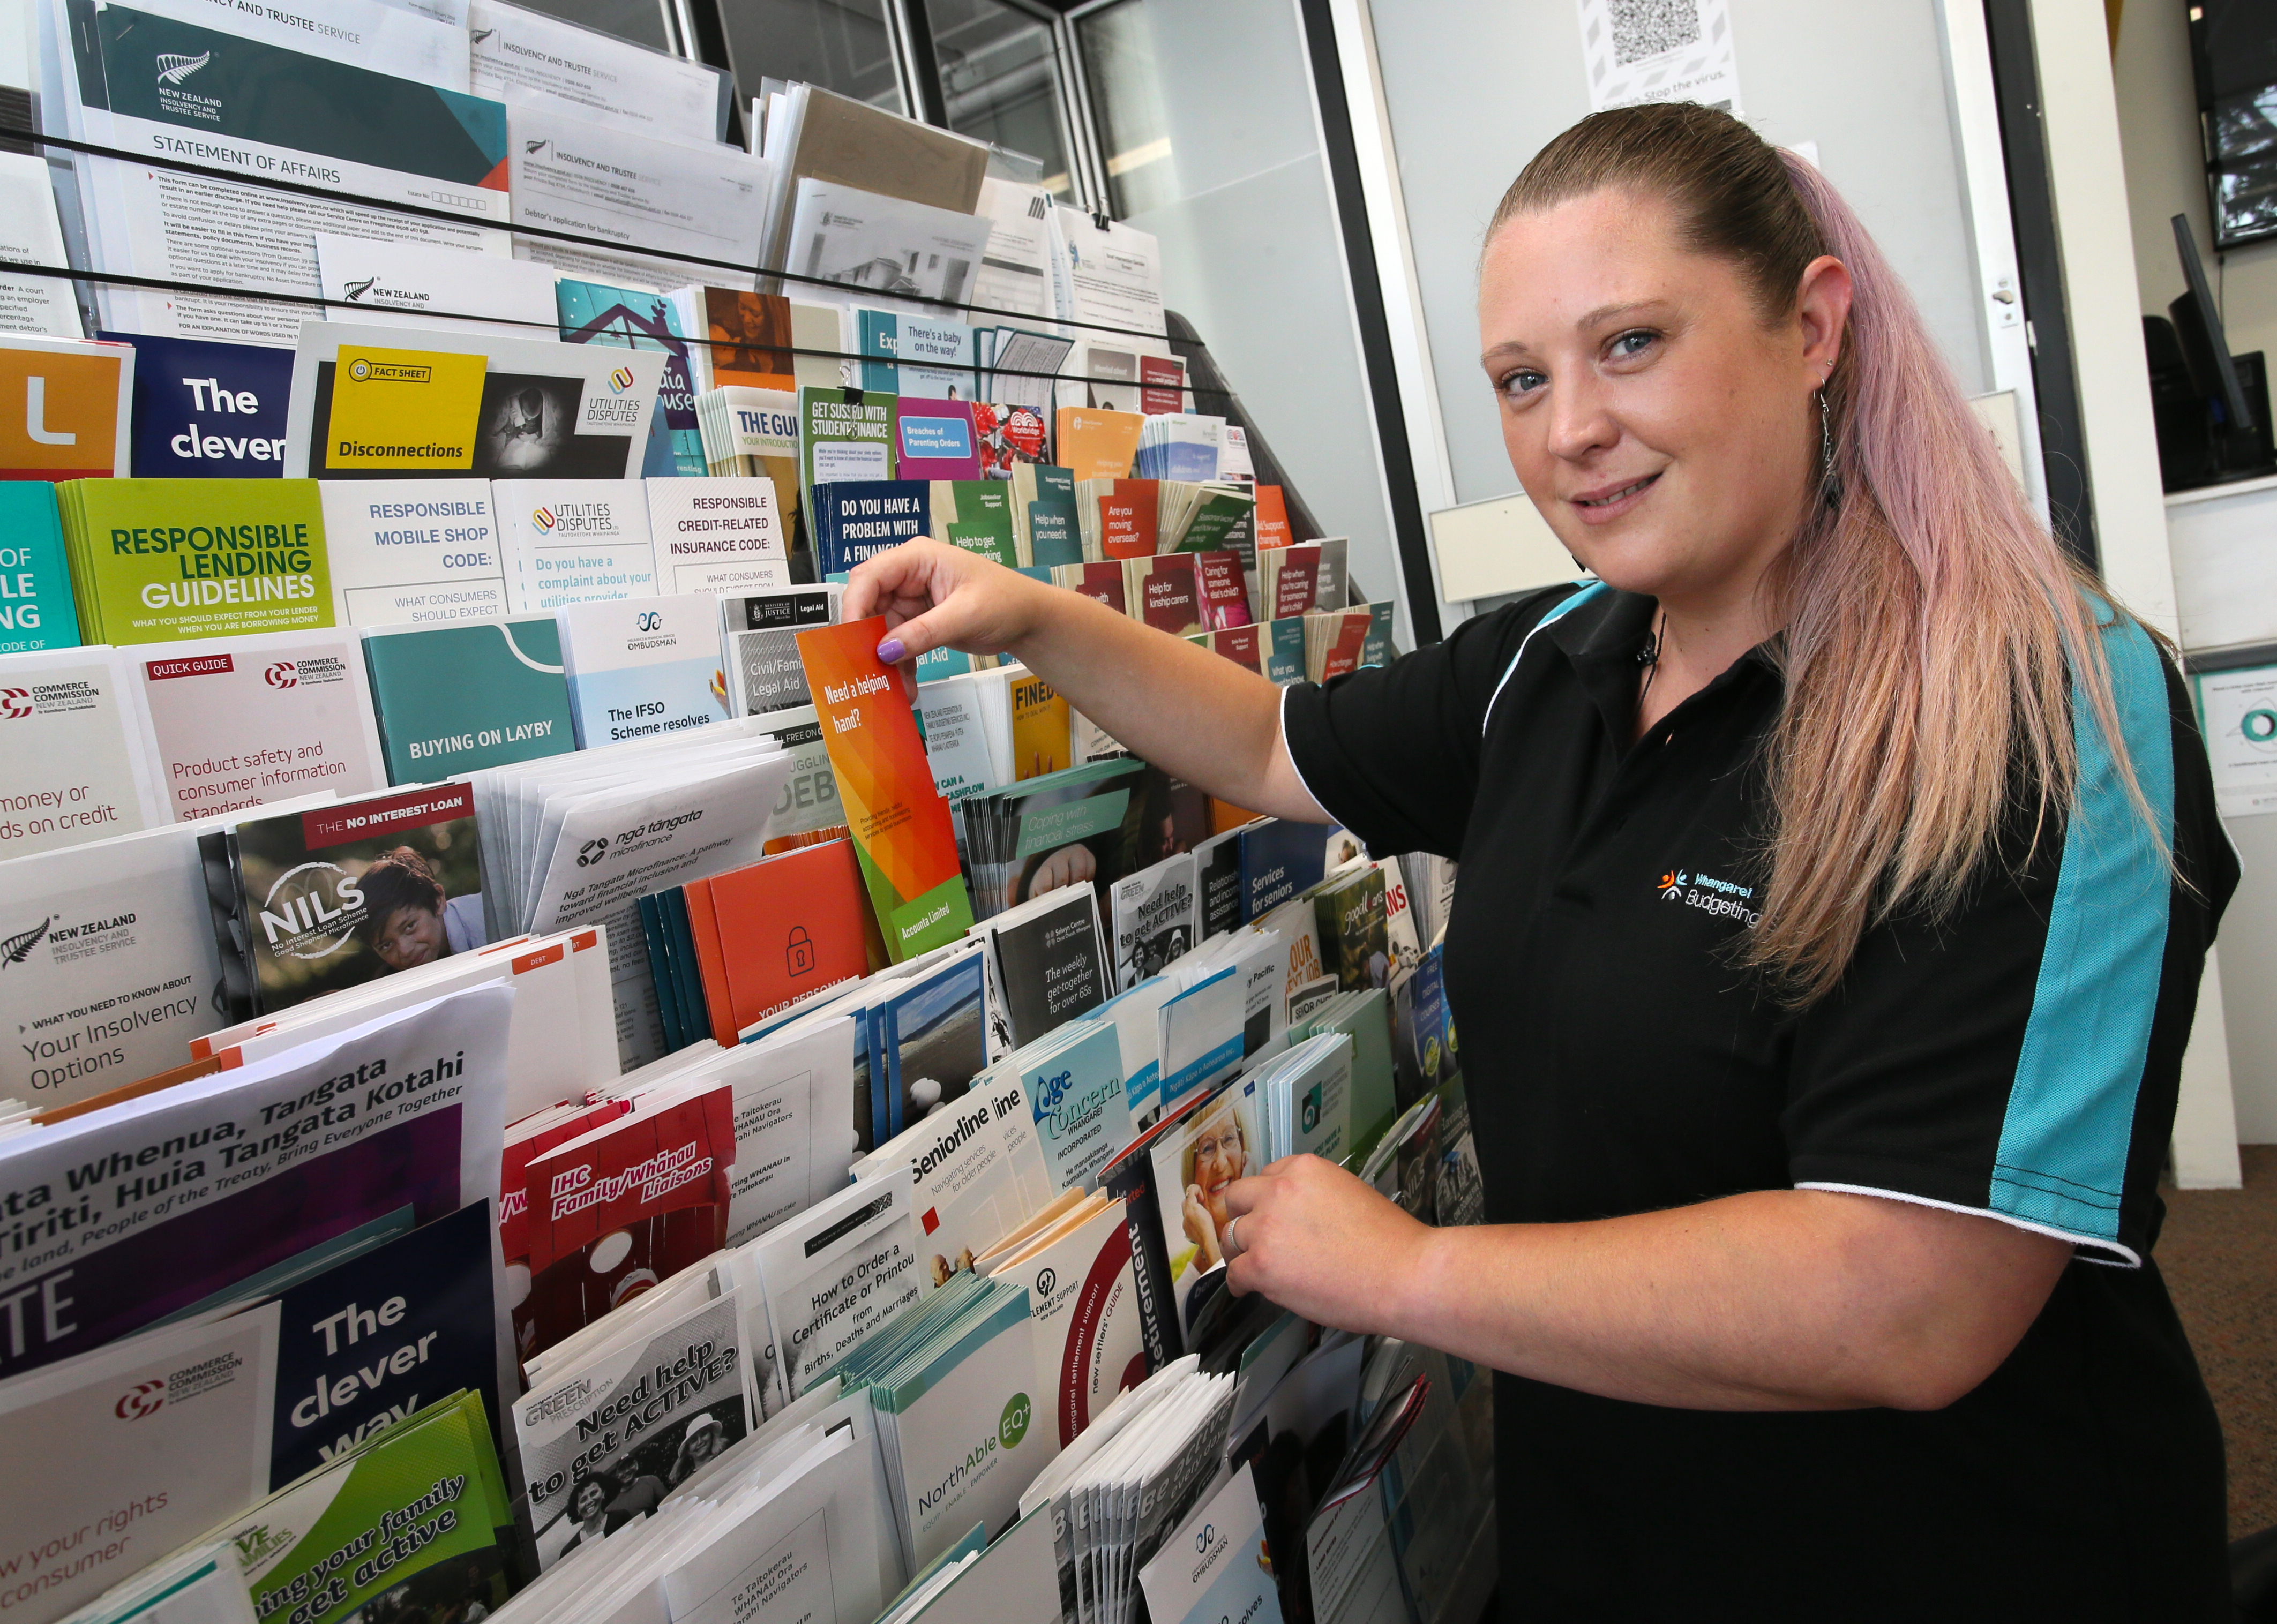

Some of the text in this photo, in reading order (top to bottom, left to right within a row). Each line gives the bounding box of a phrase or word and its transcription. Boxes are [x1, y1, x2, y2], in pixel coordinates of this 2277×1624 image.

[266, 8, 361, 44] TRUSTEE SERVICE
[504, 42, 591, 75] INSOLVENCY AND TRUSTEE
[159, 87, 222, 107] NEW ZEALAND
[1645, 88, 1671, 99] Stop
[1673, 81, 1690, 92] the
[153, 134, 341, 184] STATEMENT OF AFFAIRS
[525, 209, 630, 240] Debtor's application for bankruptcy
[909, 326, 935, 340] There's
[944, 332, 961, 345] baby
[915, 343, 956, 358] on the way!
[374, 367, 427, 378] FACT SHEET
[183, 378, 259, 415] The
[171, 424, 287, 462] clever
[907, 427, 935, 435] Breaches
[909, 439, 938, 448] Parenting
[339, 441, 463, 459] Disconnections
[370, 501, 486, 518] RESPONSIBLE
[555, 503, 610, 517] UTILITIES
[693, 497, 767, 510] RESPONSIBLE
[841, 498, 920, 516] DO YOU HAVE A
[1108, 507, 1132, 517] Are you
[111, 524, 309, 555] RESPONSIBLE
[374, 527, 489, 546] MOBILE SHOP
[556, 517, 612, 531] DISPUTES
[678, 518, 768, 532] CREDIT-RELATED
[843, 520, 918, 539] PROBLEM WITH
[1108, 532, 1139, 543] overseas?
[1109, 520, 1132, 531] moving
[442, 553, 493, 569] CODE:
[670, 540, 770, 555] INSURANCE CODE:
[180, 549, 312, 580] LENDING
[141, 574, 315, 610] GUIDELINES
[538, 573, 651, 589] complaint about your
[1149, 582, 1172, 595] Help for
[132, 605, 318, 629] WHAT YOU SHOULD EXPECT FROM YOUR LENDER
[765, 607, 791, 616] JUSTICE
[800, 605, 814, 614] Legal
[1149, 595, 1188, 610] kinship carers
[627, 638, 676, 651] OMBUDSMAN
[153, 658, 228, 676] QUICK GUIDE
[752, 679, 800, 698] Legal Aid
[824, 674, 890, 705] Need a helping
[608, 701, 665, 723] The IFSO
[611, 713, 710, 741] Scheme resolves
[832, 709, 861, 735] hand?
[409, 720, 553, 760] BUYING ON LAYBY
[173, 742, 324, 779] Product safety and
[178, 760, 346, 801] consumer information
[317, 796, 463, 835] THE NO INTEREST LOAN
[616, 810, 703, 844] ngā tāngata
[609, 834, 672, 860] microfinance
[1253, 866, 1284, 894] Services
[1695, 873, 1753, 899] Whangarei
[259, 877, 365, 944] NILS
[1252, 882, 1293, 914] for seniors
[1686, 889, 1761, 928] Budgeting
[902, 901, 950, 940] Accounta Limited
[1046, 953, 1087, 982] The weekly
[1047, 969, 1092, 1001] get-together
[1050, 985, 1091, 1014] for over 65s
[32, 975, 192, 1031] WHAT YOU NEED TO KNOW ABOUT
[22, 994, 198, 1062] Your Insolvency
[30, 1047, 125, 1092] Options
[1033, 1071, 1072, 1125] Age
[1049, 1078, 1121, 1139] Concern
[67, 1057, 386, 1191] Whenua, Tangata
[115, 1051, 464, 1208] Huia Tangata Kotahi
[1067, 1107, 1103, 1136] WHANGAREI
[913, 1108, 989, 1184] Seniorline
[1057, 1125, 1102, 1161] INCORPORATED
[551, 1141, 696, 1221] Family/Whānau
[551, 1164, 592, 1199] IHC
[641, 1157, 713, 1204] Liaisons
[811, 1245, 900, 1311] How to Order a
[792, 1280, 874, 1344] Certificate or
[1083, 1283, 1099, 1324] support
[312, 1294, 407, 1357] The
[1095, 1318, 1108, 1365] settlers'
[1106, 1282, 1123, 1317] GUIDE
[1072, 1327, 1084, 1385] settlement
[291, 1329, 438, 1428] clever
[576, 1340, 713, 1442] Need help
[528, 1347, 736, 1505] to get ACTIVE?
[1001, 1403, 1031, 1439] EQ+
[918, 1434, 997, 1515] NorthAble
[311, 1473, 465, 1588] your family
[353, 1508, 456, 1587] active
